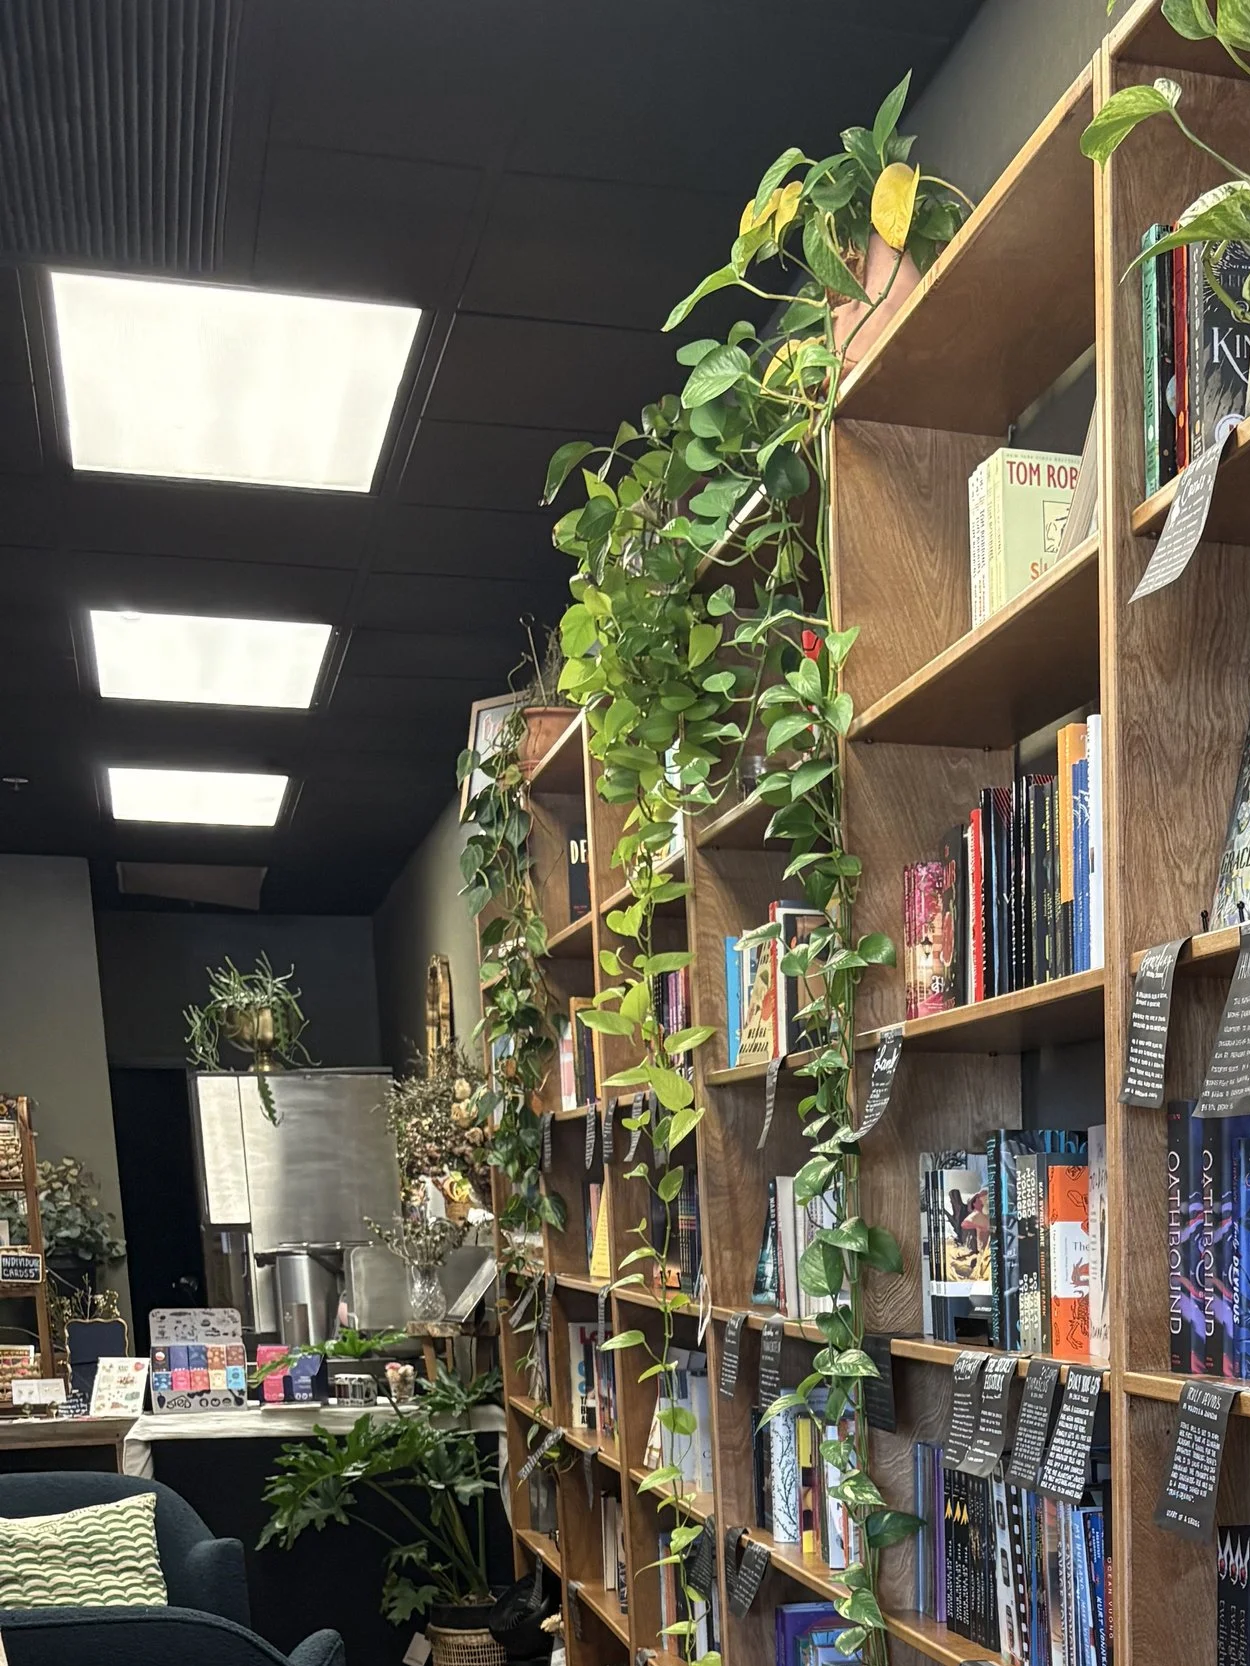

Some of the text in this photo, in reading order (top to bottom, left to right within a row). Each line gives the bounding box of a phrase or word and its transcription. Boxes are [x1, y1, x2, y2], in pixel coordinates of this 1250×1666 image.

[1006, 461, 1041, 486] TOM
[569, 839, 588, 864] DE
[1073, 1241, 1089, 1251] The
[1167, 1150, 1182, 1336] OATHBOUND
[1202, 1150, 1215, 1336] OATHBOUND
[3, 1269, 28, 1278] CARDS
